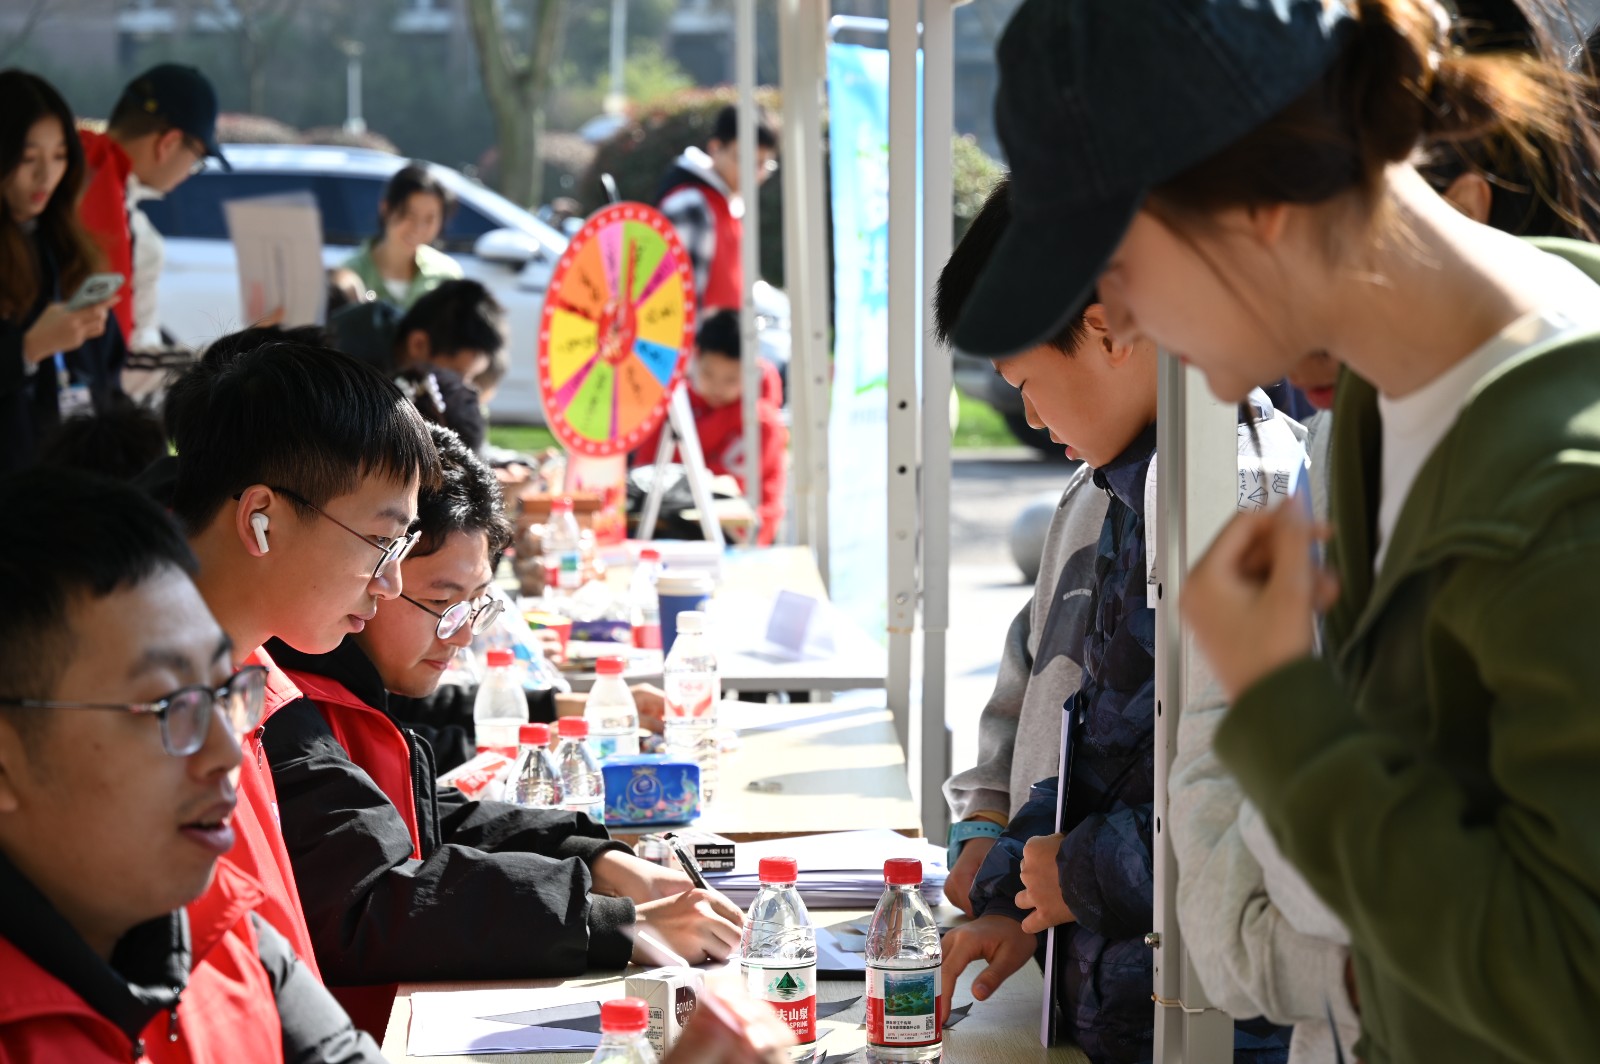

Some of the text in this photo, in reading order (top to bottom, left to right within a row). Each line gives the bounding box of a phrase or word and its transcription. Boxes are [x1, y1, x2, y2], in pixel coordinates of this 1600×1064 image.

[676, 999, 694, 1014] BONUS
[776, 1007, 808, 1022] 夫山泉
